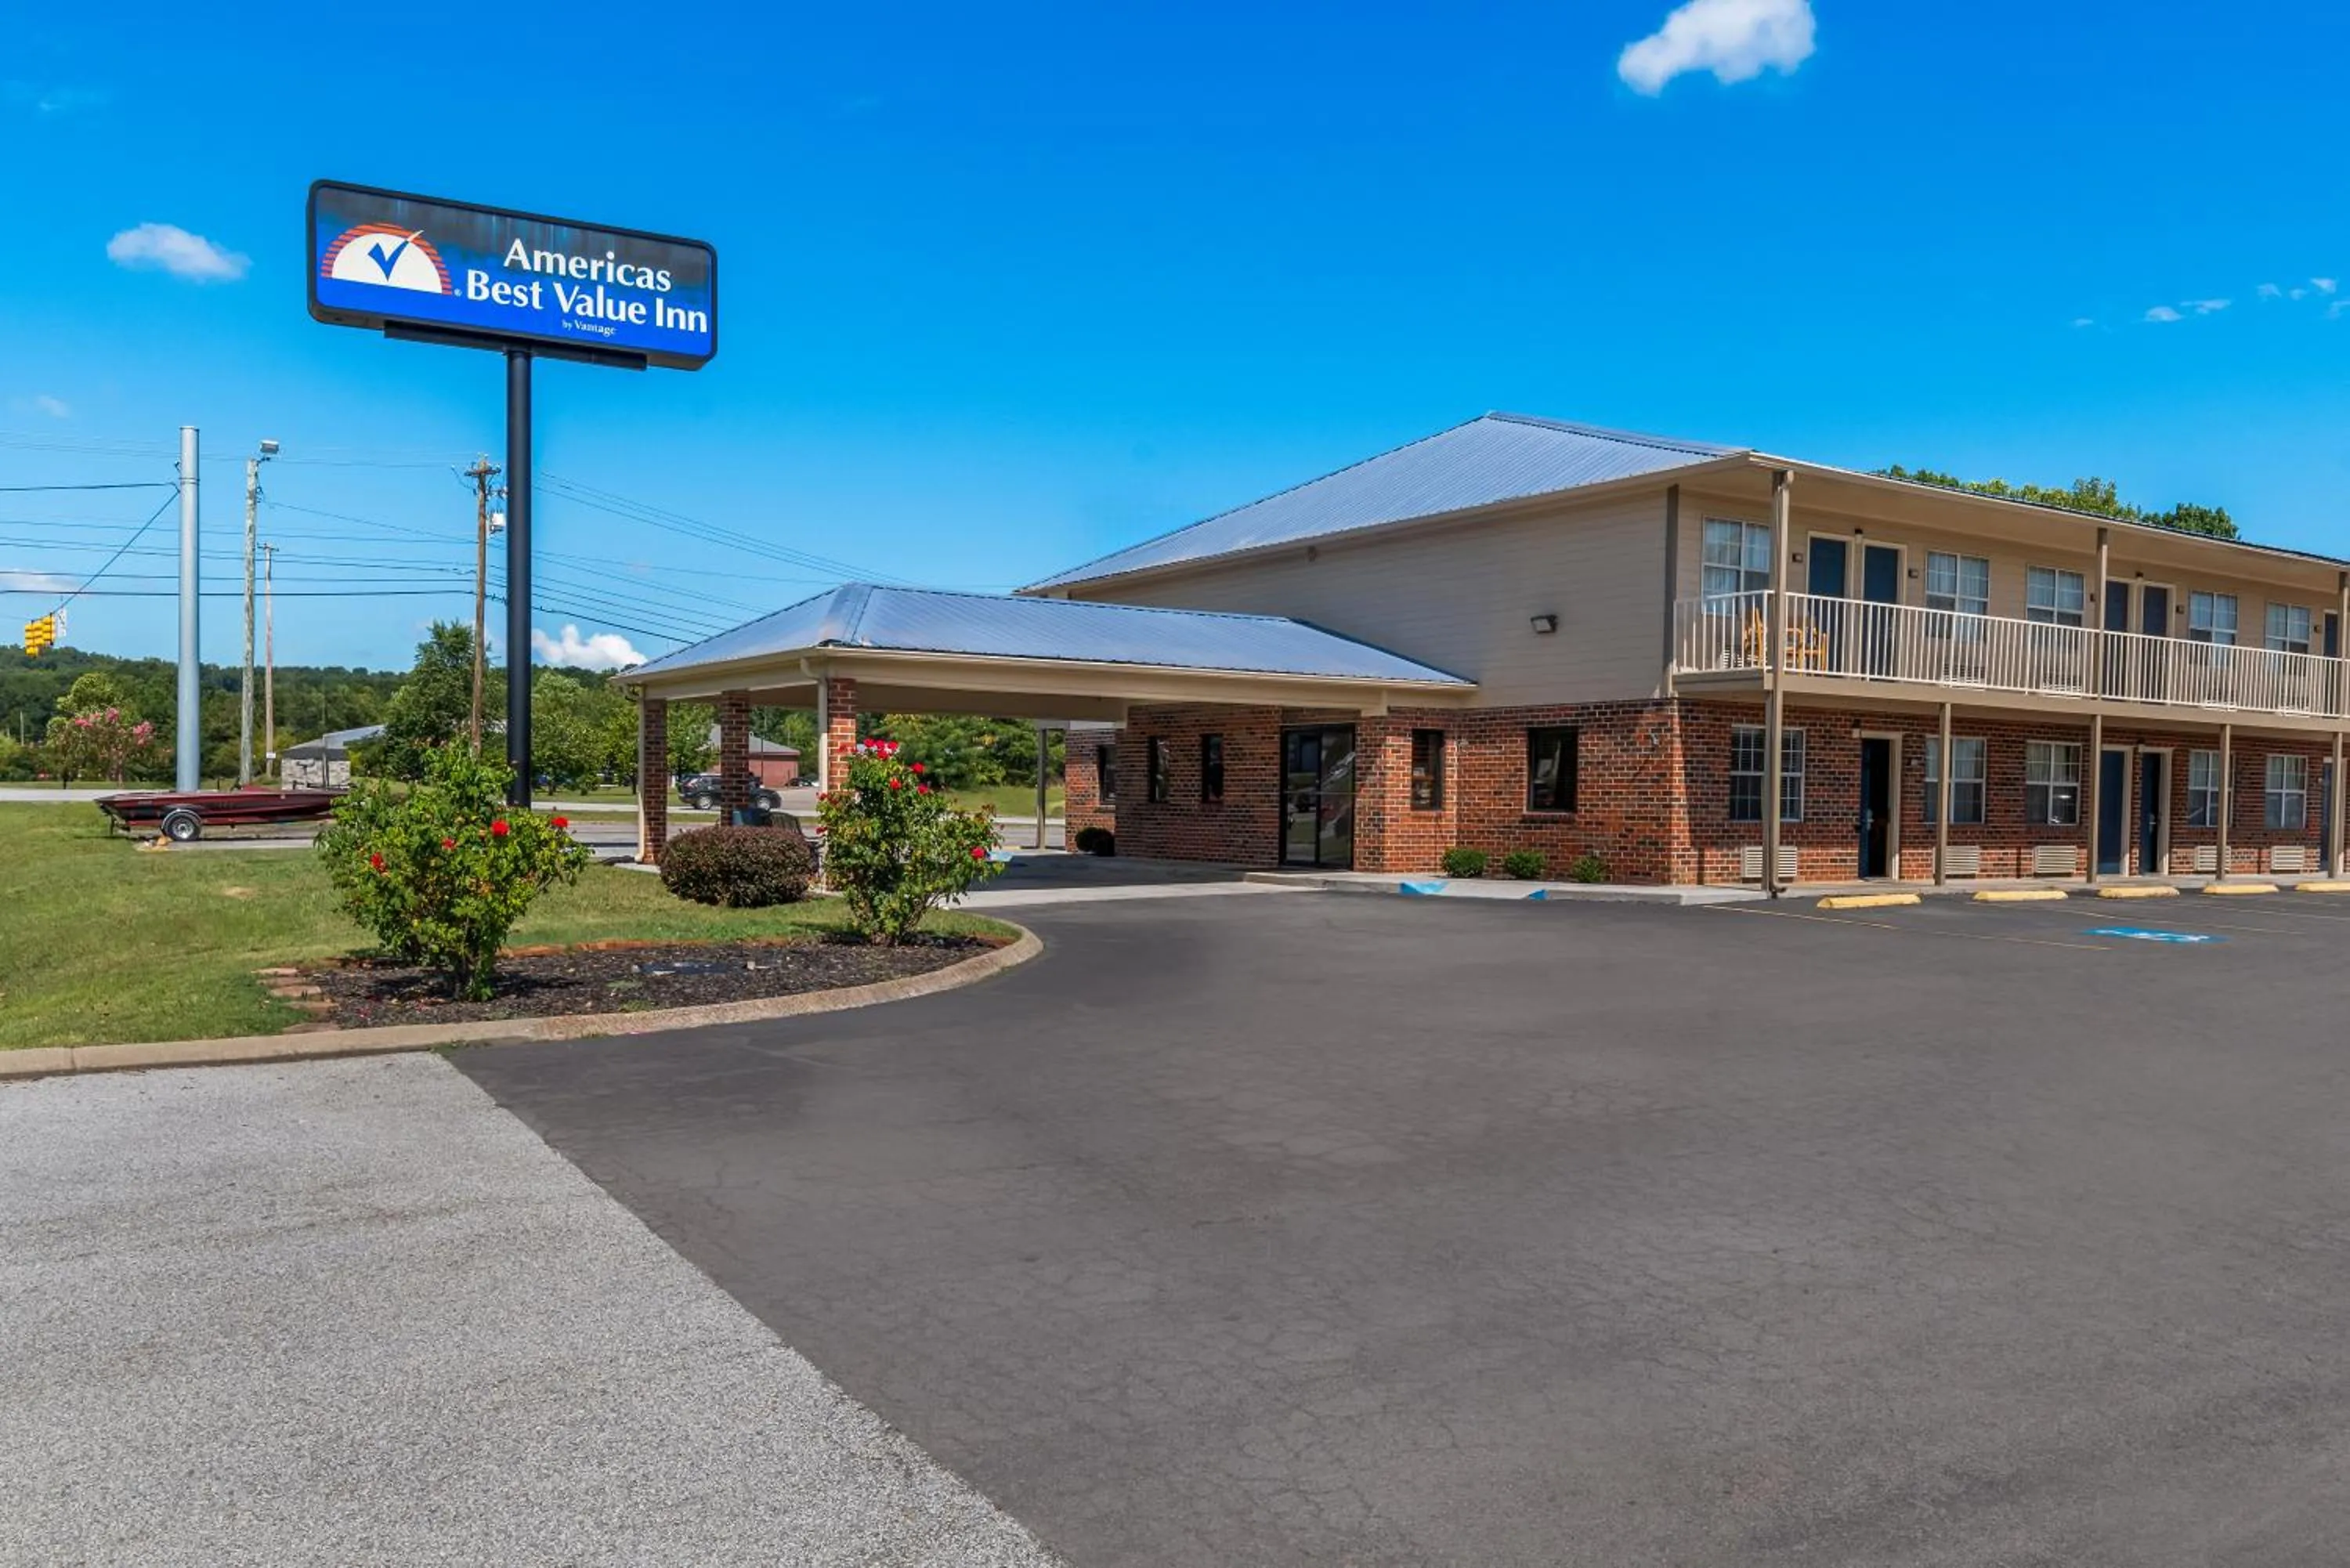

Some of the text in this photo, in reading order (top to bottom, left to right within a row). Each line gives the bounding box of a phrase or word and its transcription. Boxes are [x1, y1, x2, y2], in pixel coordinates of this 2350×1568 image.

[503, 238, 671, 291] Americas
[468, 269, 707, 333] Best Value Inn
[562, 320, 616, 337] by Vantage
